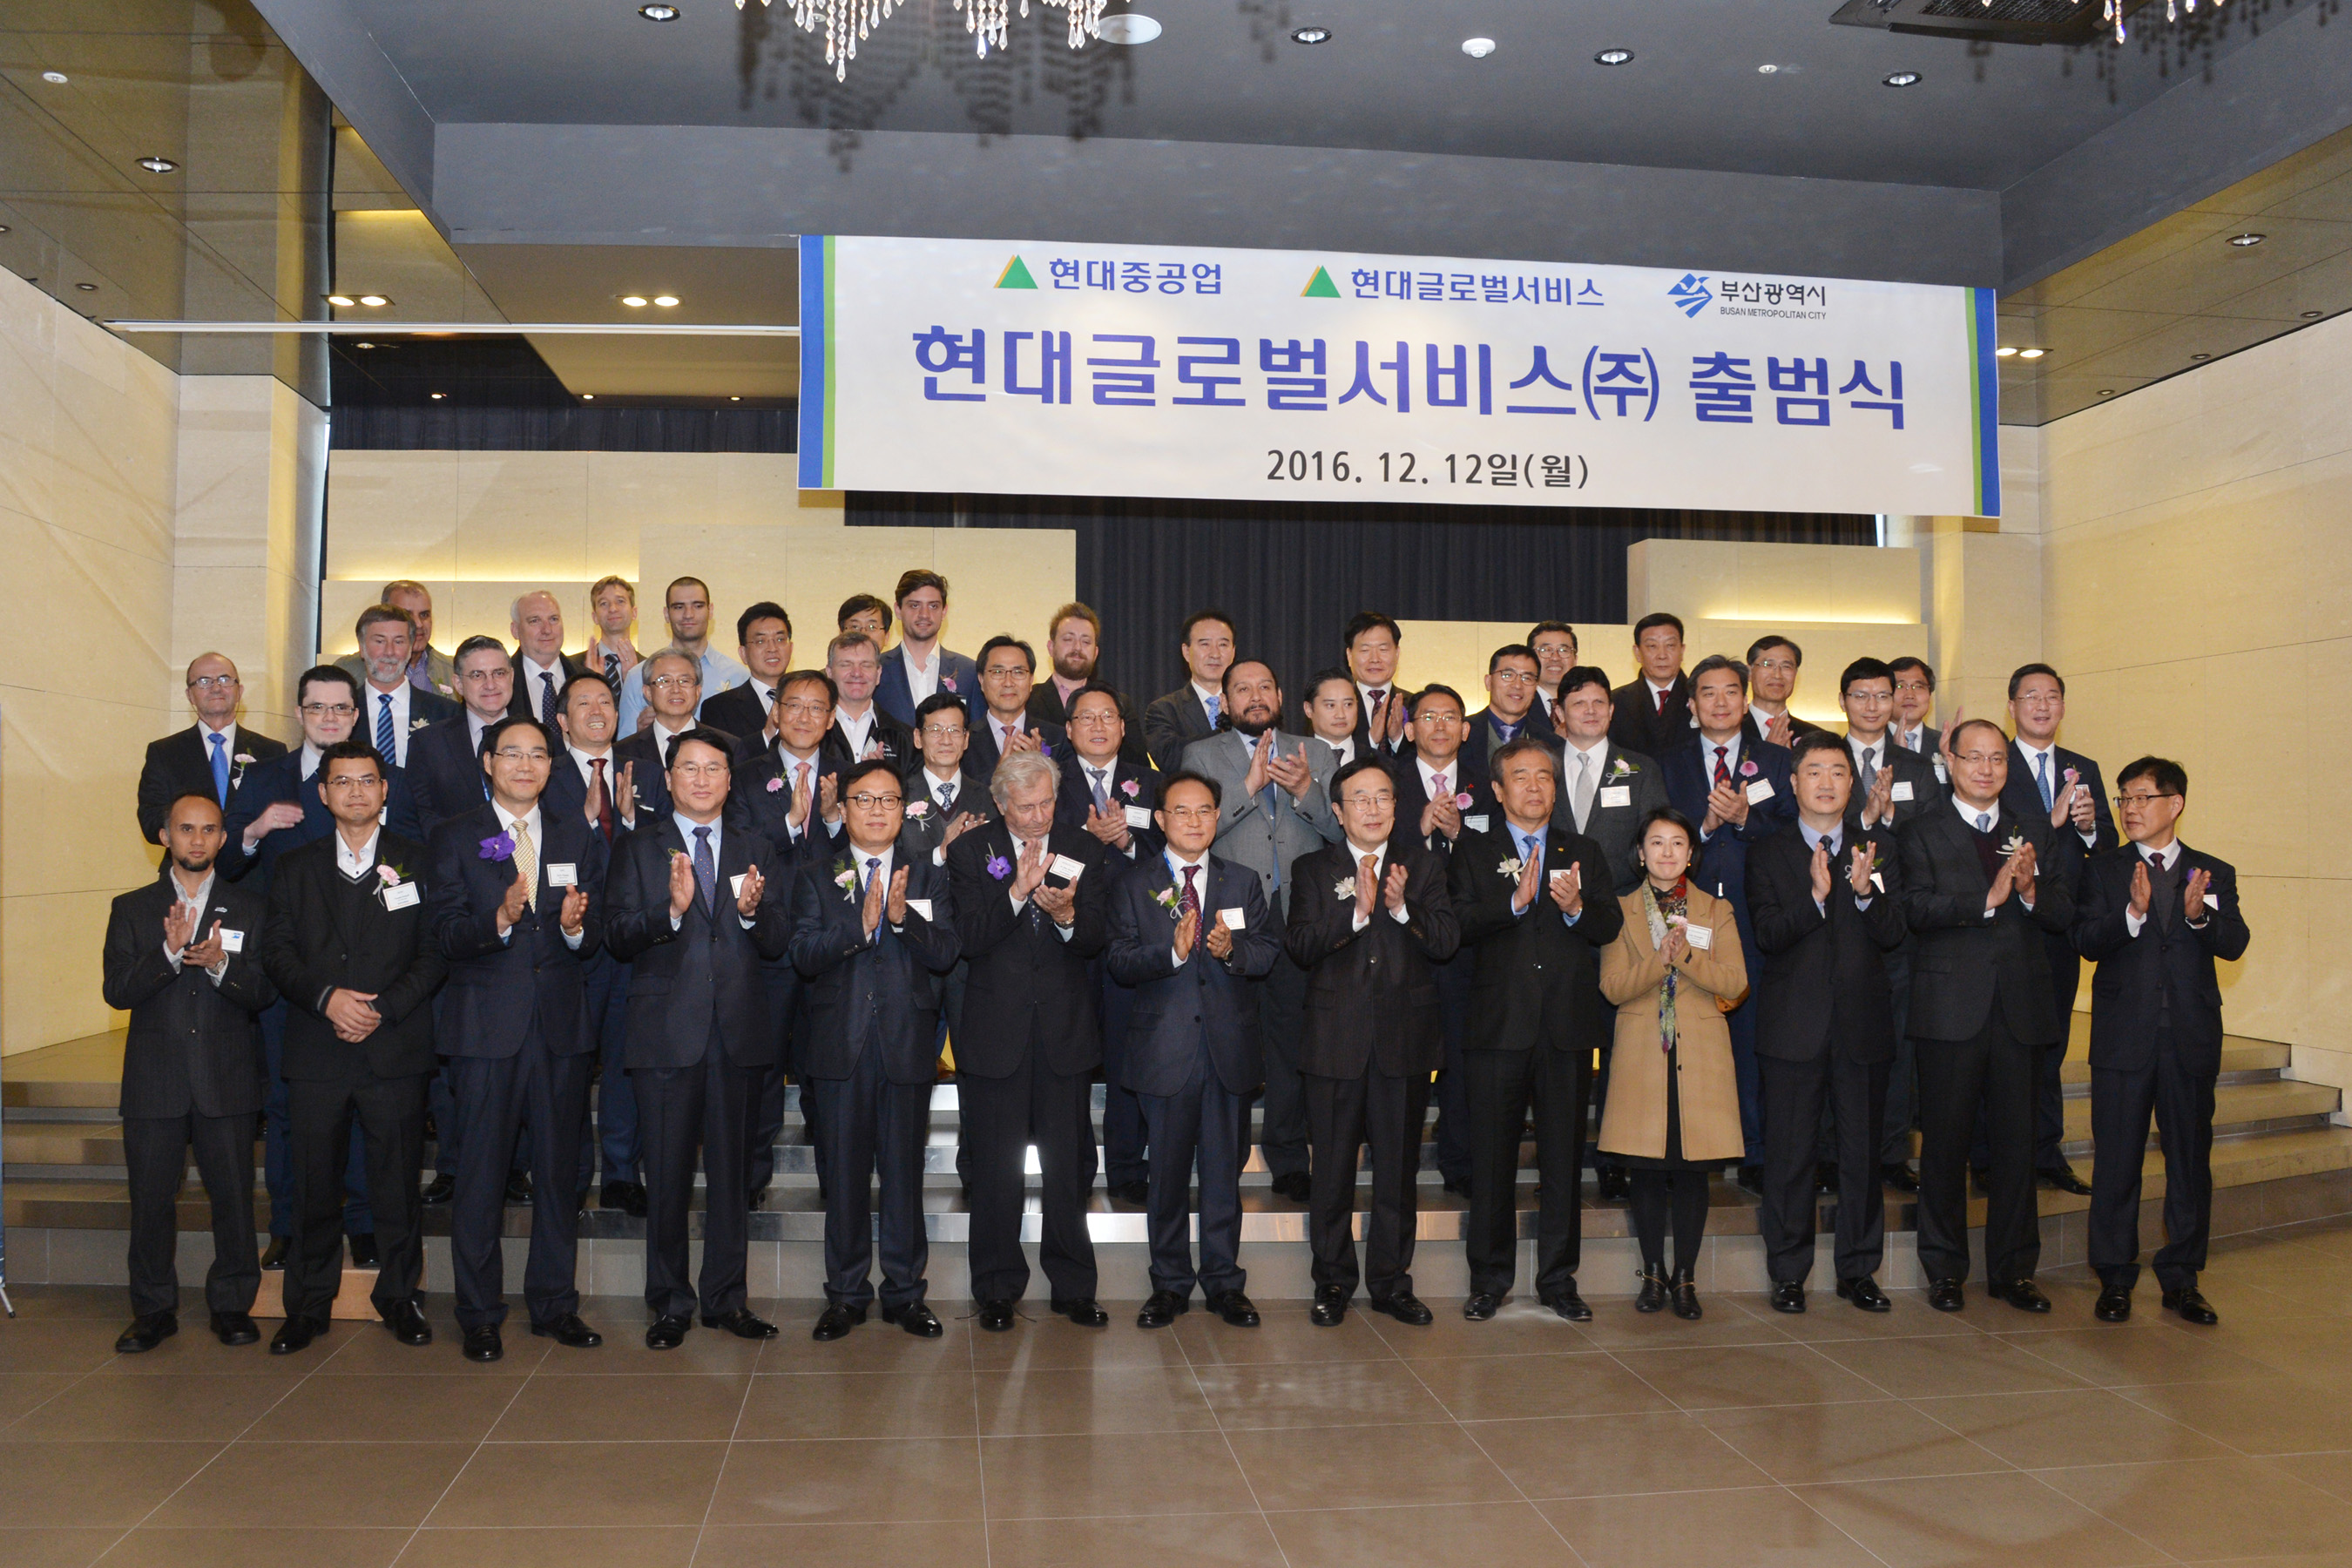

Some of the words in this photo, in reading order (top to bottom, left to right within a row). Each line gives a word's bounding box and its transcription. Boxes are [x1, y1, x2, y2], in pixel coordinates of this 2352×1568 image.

[1049, 258, 1221, 294] 현대중공업
[1351, 268, 1605, 306] 현대글로벌서비스
[1720, 280, 1826, 307] 부산광역시
[1720, 306, 1747, 316] BUSAN
[1747, 308, 1807, 320] METROPOLITAN
[1808, 311, 1827, 320] CITY
[1689, 351, 1904, 430] 출범식
[1267, 449, 1362, 483] 2016.
[1378, 452, 1429, 485] 12.
[1444, 453, 1589, 490] 12일(월)
